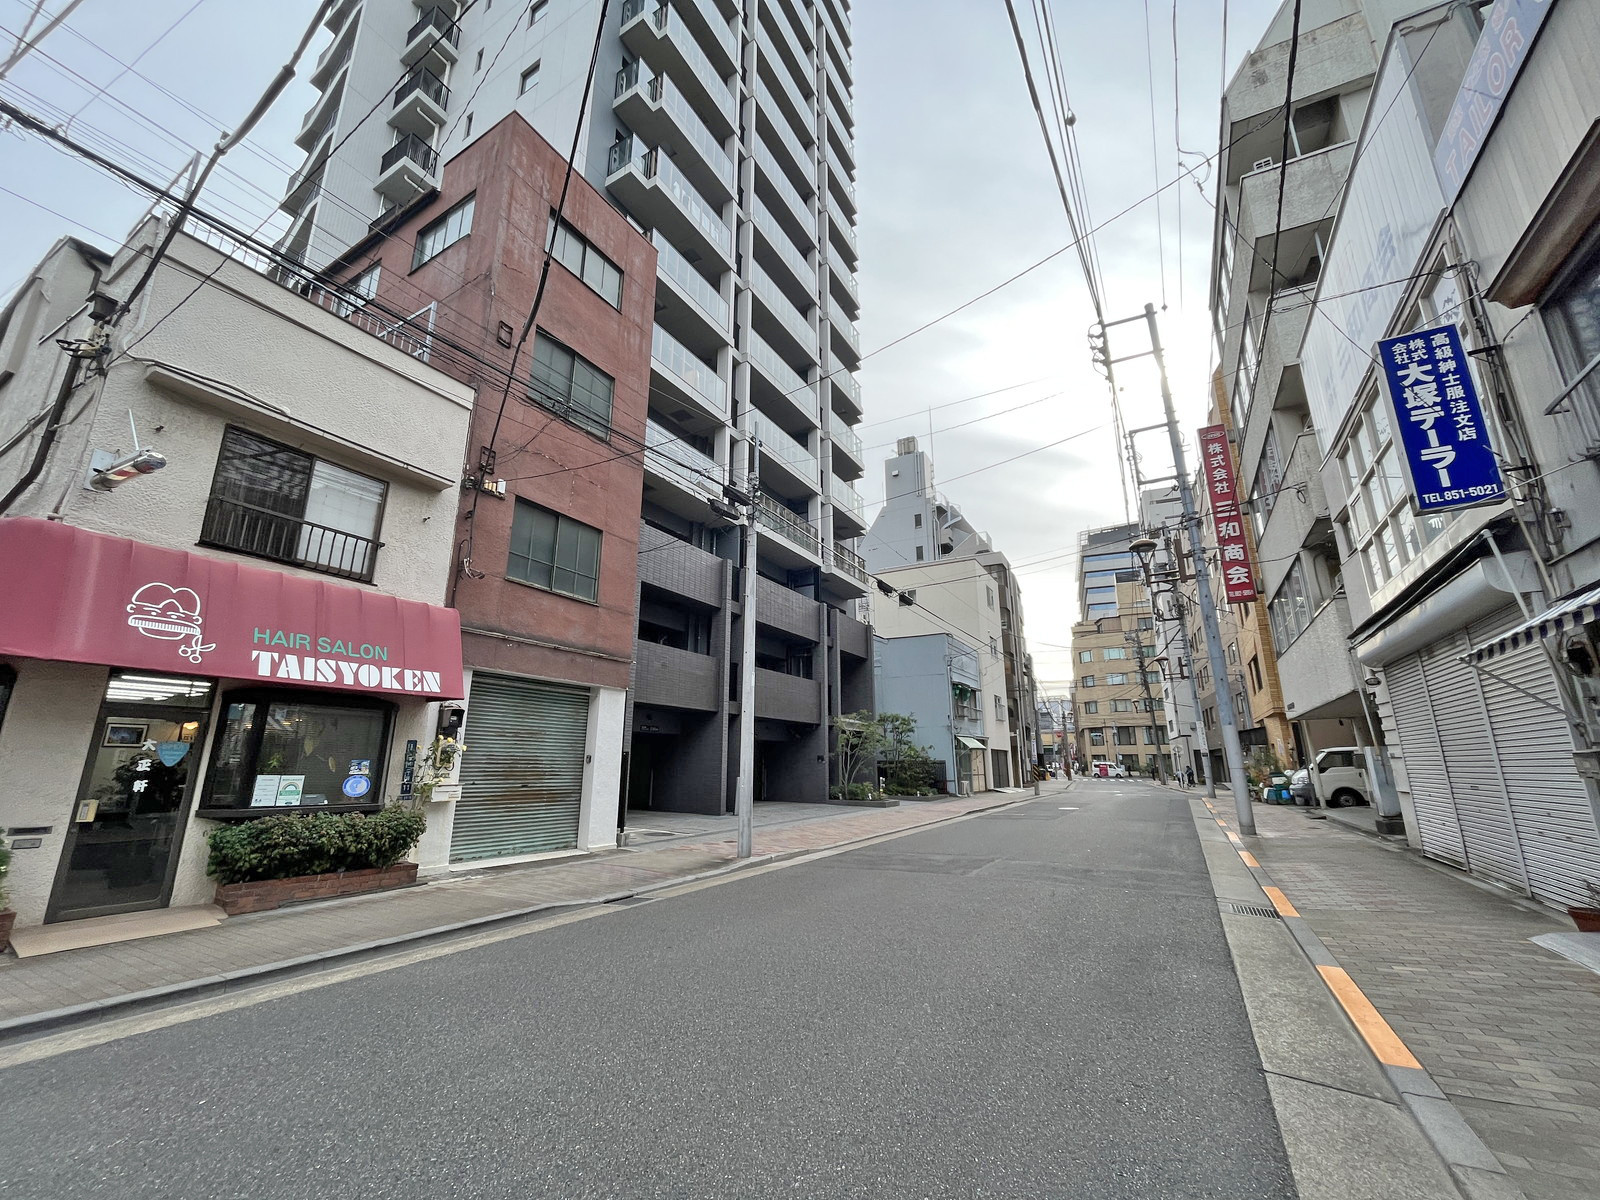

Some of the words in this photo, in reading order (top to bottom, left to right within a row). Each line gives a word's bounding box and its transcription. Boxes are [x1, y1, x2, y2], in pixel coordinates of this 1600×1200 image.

[1444, 16, 1525, 187] TAILOR
[1430, 332, 1477, 442] 高級紳士服注文店
[1397, 362, 1456, 488] 大塚テーラー
[1207, 442, 1231, 495] 株式会社
[1422, 492, 1445, 504] TEL
[1444, 484, 1499, 501] 851-5021
[1215, 500, 1250, 585] 三和商会
[251, 650, 441, 693] TAISYOKEN
[253, 627, 311, 651] HAIR
[317, 636, 388, 661] SALON
[132, 738, 158, 793] 大正軒
